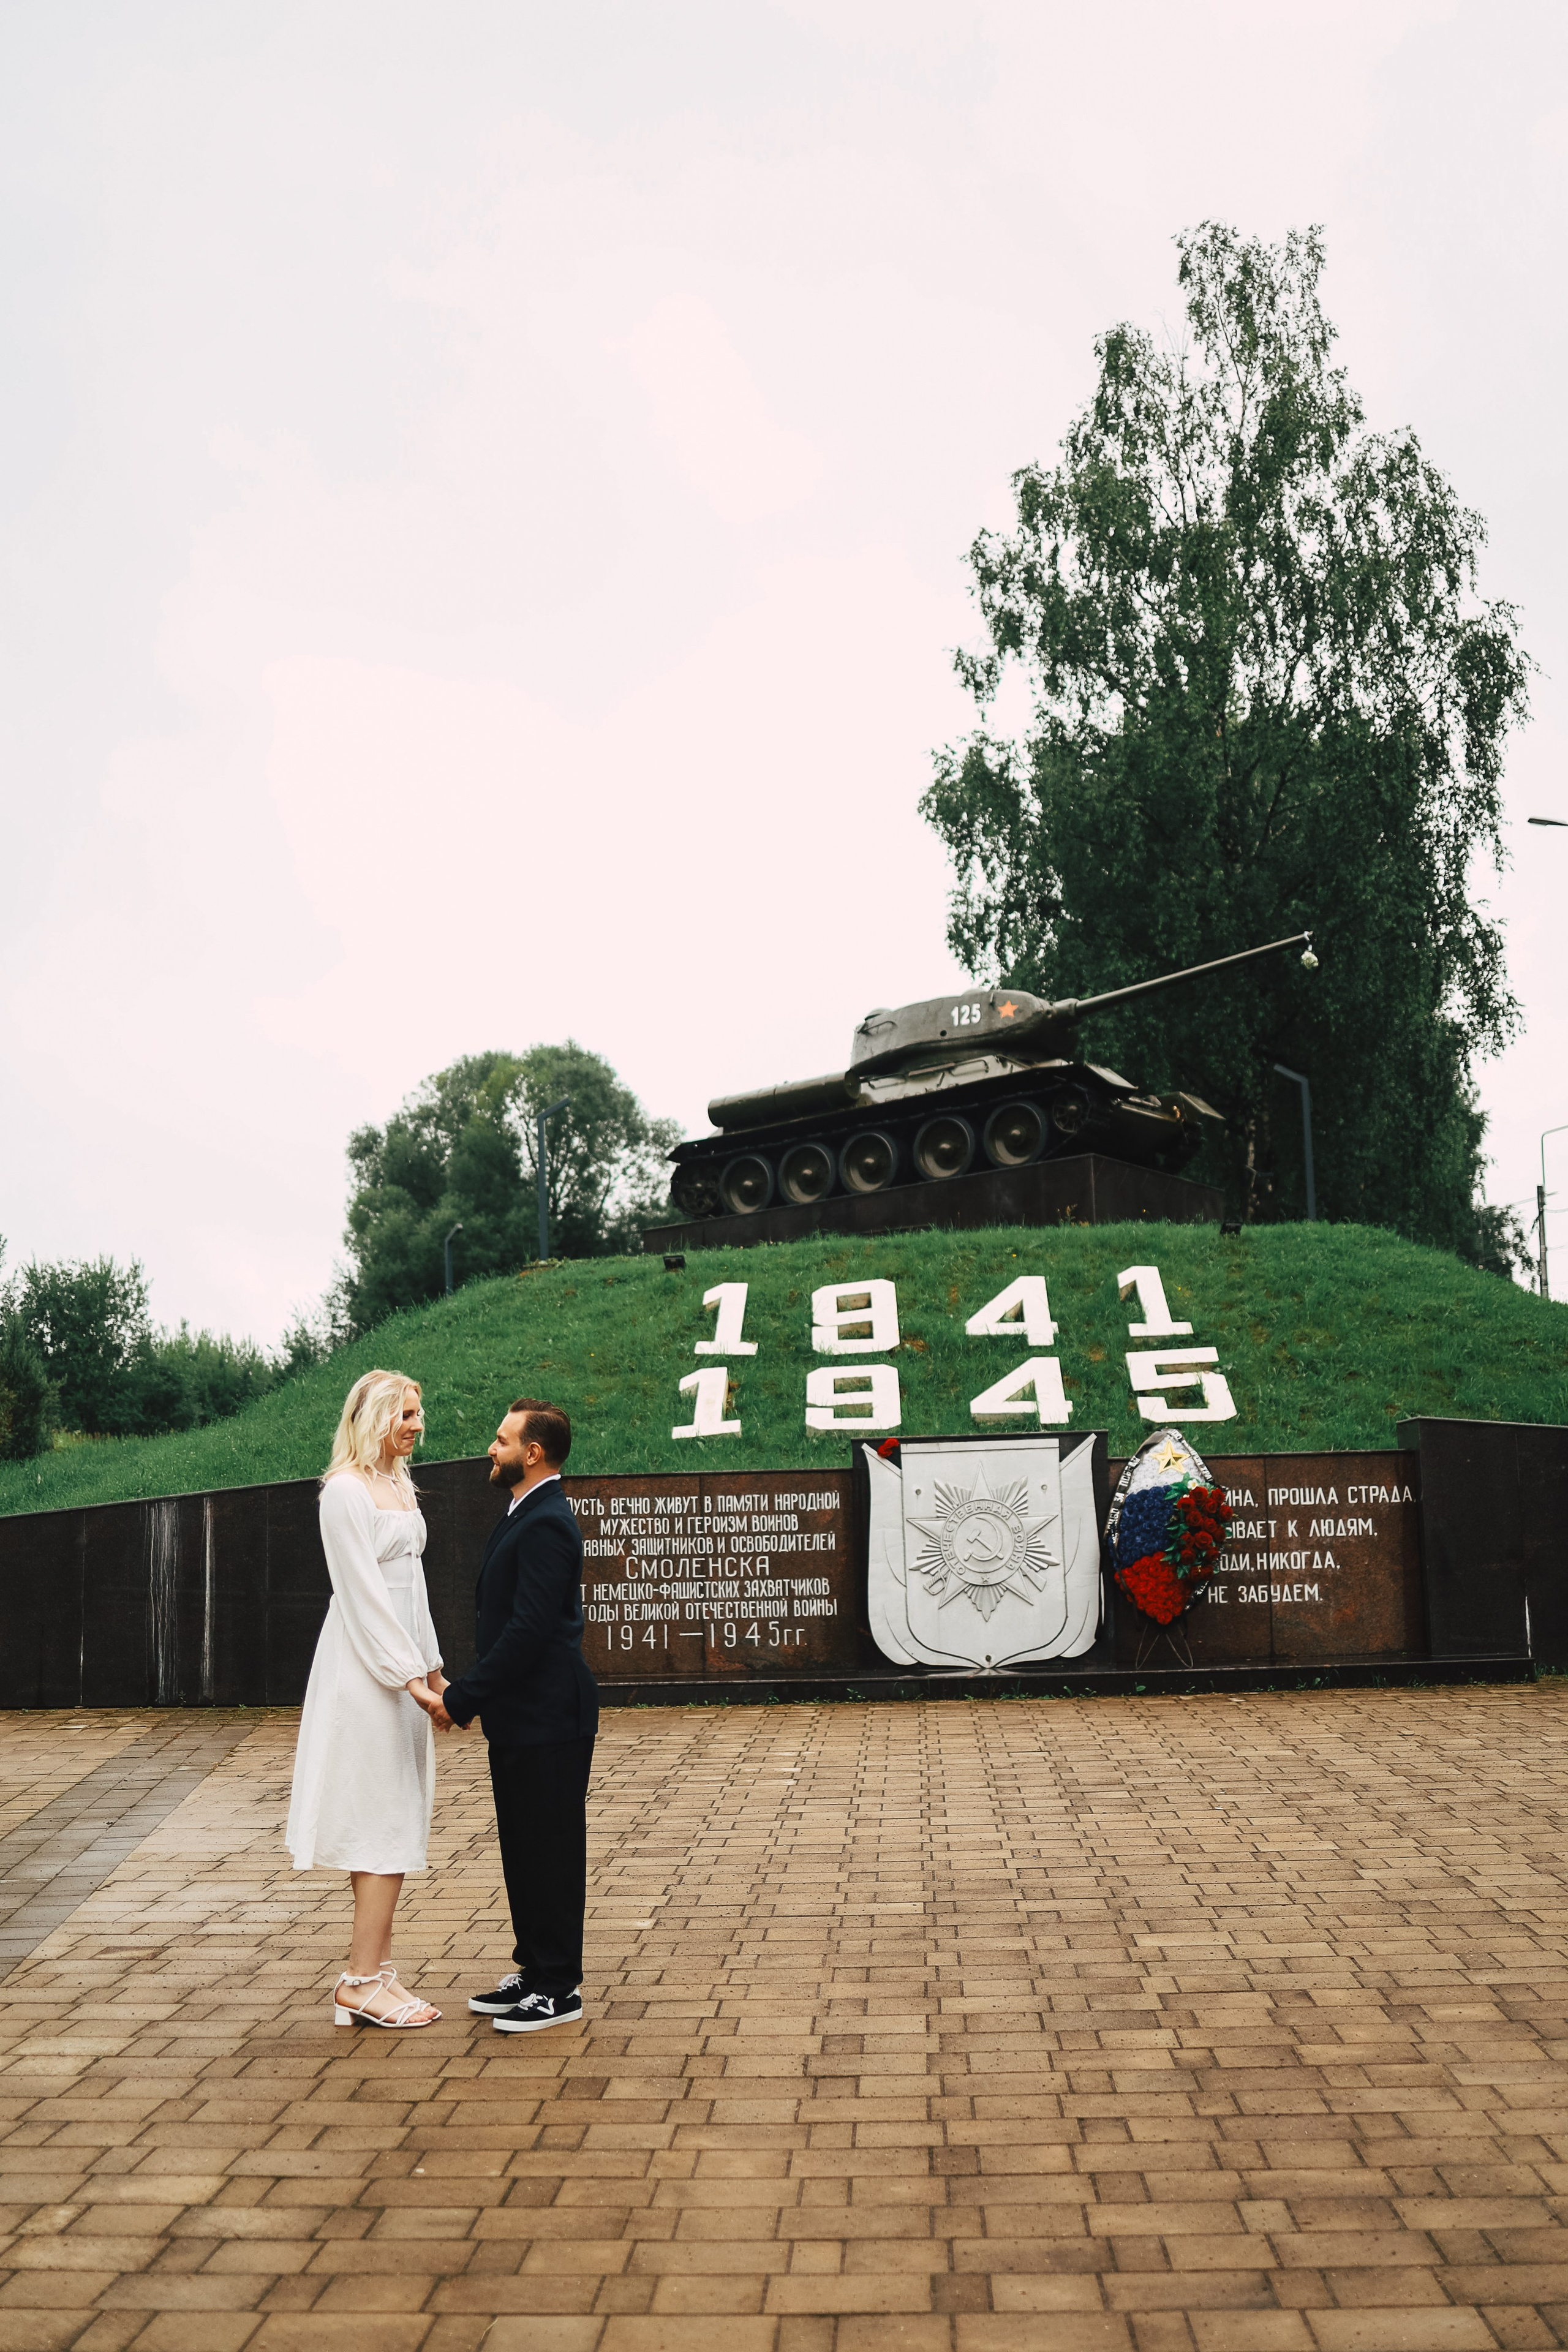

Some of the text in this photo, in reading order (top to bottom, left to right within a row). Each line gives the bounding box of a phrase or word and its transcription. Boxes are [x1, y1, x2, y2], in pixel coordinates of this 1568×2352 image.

[951, 1003, 981, 1027] 125
[694, 1265, 1193, 1356] 1941
[672, 1346, 1237, 1439] 1945
[611, 1497, 650, 1515] ВЕЧНО
[655, 1496, 699, 1514] ЖИВУТ
[704, 1496, 712, 1513] В
[718, 1494, 768, 1512] ПАМЯТИ
[775, 1490, 840, 1511] НАРОДНОЙ
[1268, 1487, 1338, 1505] ПРОШЛА
[1348, 1485, 1417, 1504] СТРАДА,
[600, 1513, 798, 1536] МУЖЕСТВО И ГЕРОИЗМ ВОИНОВ
[1225, 1518, 1378, 1539] ЫВАЕТ К ЛЮДЯМ,
[582, 1531, 835, 1556] АВНЫХ ЗАЩИТНИКОВ И ОСВОБОДИТЕЛЕЙ
[626, 1556, 769, 1580] СМОЛЕНСКА
[580, 1578, 829, 1602] Т НЕМЕЦКО-ФАШИСТСКИХ ЗАХВАТЧИКОВ
[1208, 1586, 1227, 1604] НЕ
[1238, 1584, 1323, 1603] ЗАБУДЕМ.
[624, 1601, 679, 1621] ВЕЛИКОЙ
[685, 1598, 788, 1620] ОТЕЧЕСТВЕННОЙ
[794, 1598, 837, 1617] ВОЙНЫ
